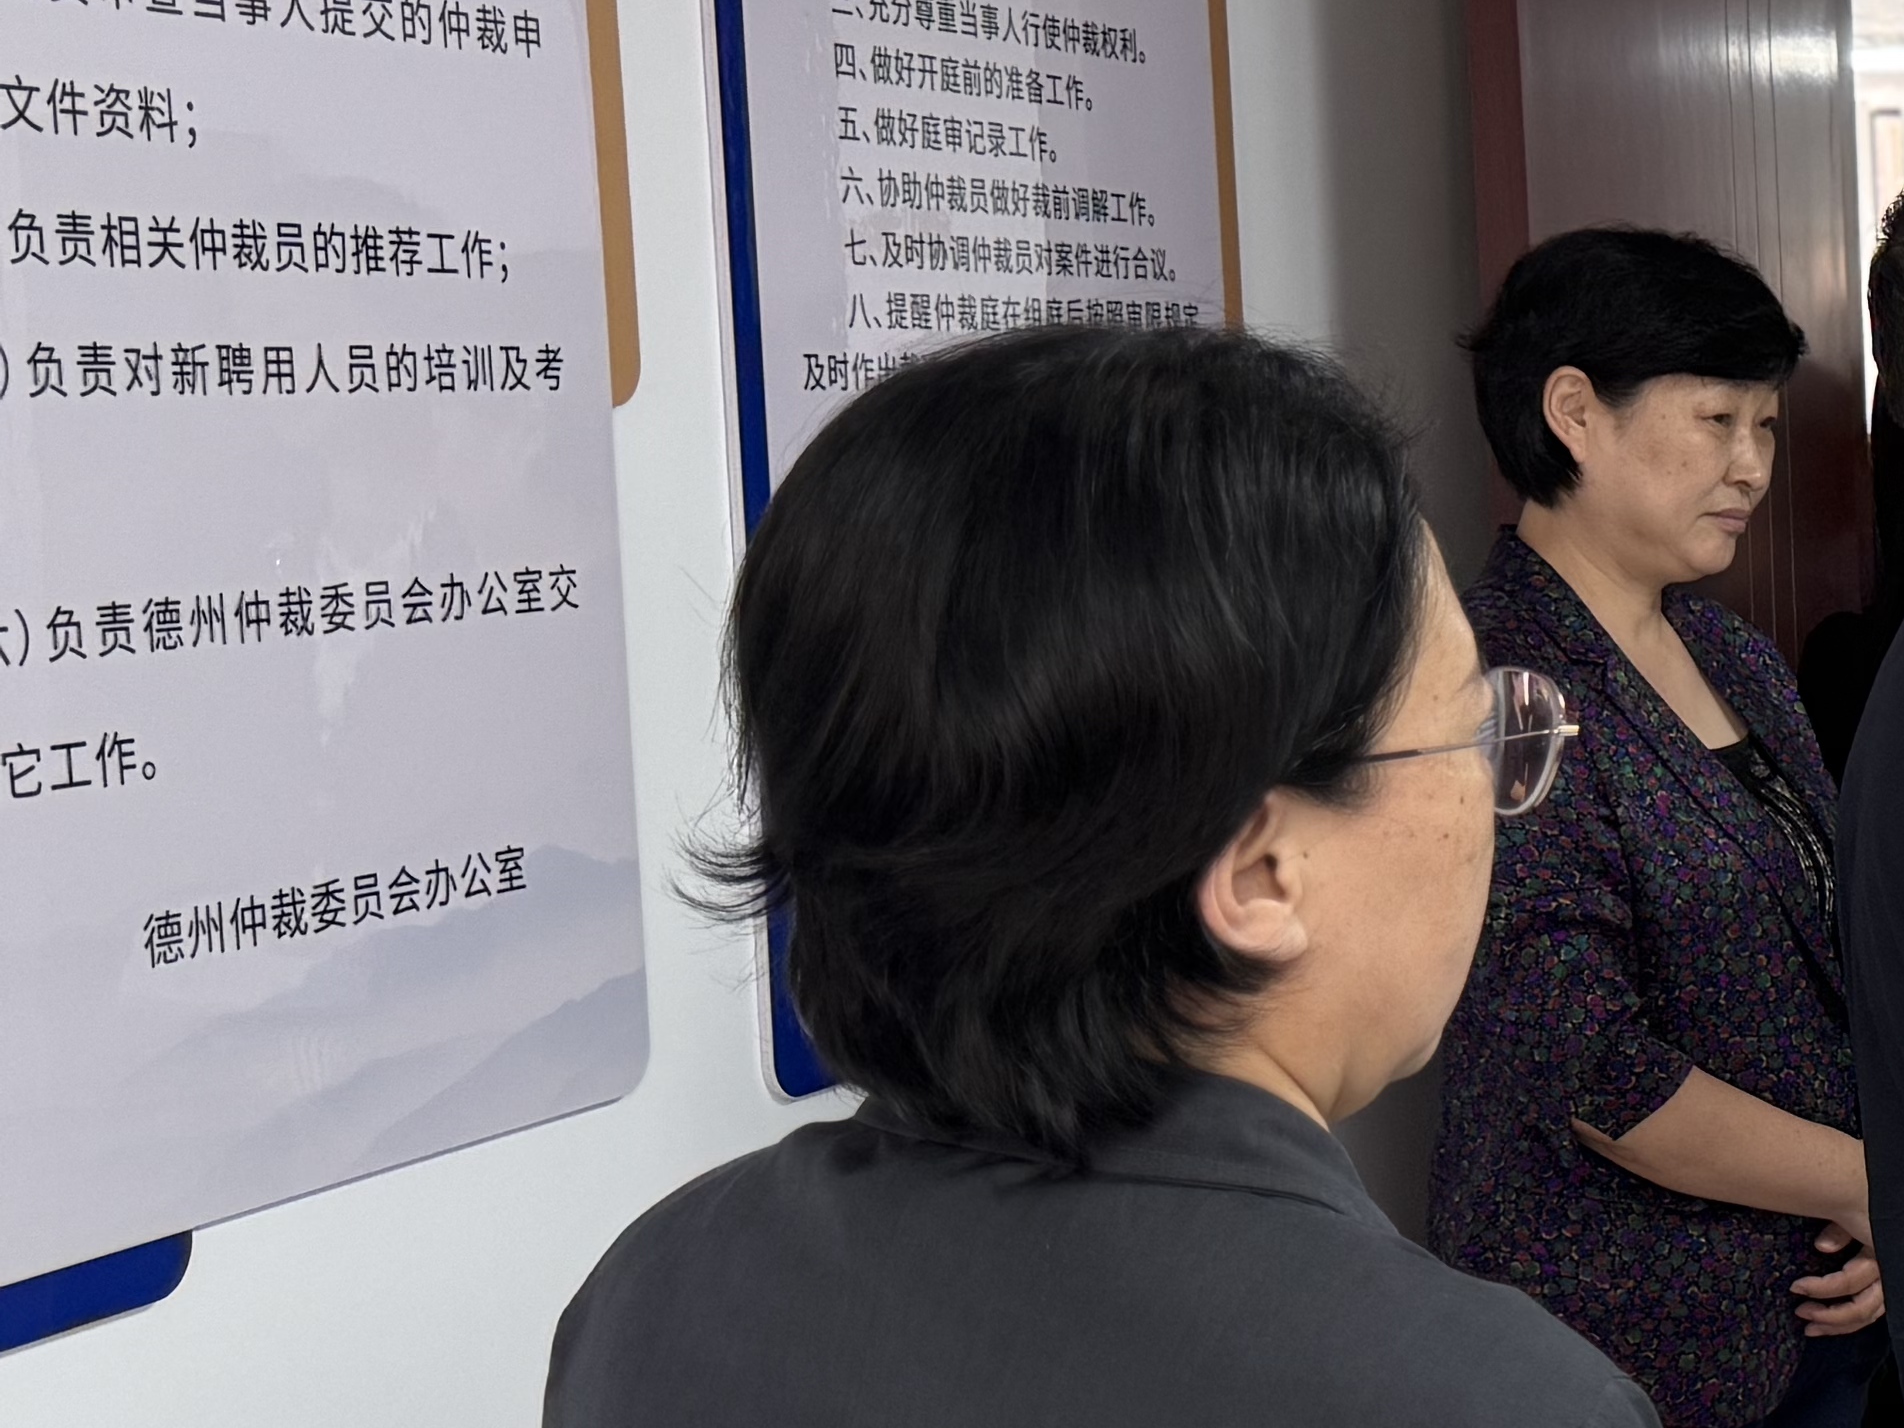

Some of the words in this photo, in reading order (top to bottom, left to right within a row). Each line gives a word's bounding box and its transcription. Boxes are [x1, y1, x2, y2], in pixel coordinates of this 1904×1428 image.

[0, 74, 198, 146] 文件资料；
[833, 42, 1093, 112] 四、做好开庭前的准备工作。
[837, 105, 1057, 164] 五、做好庭审记录工作。
[840, 167, 1156, 227] 六、协助仲裁员做好裁前调解工作。
[844, 230, 1176, 283] 七、及时协调仲裁员对案件进行合议。
[0, 563, 581, 667] ）负责德州仲裁委员会办公室交
[2, 731, 158, 799] 它工作。
[142, 843, 528, 969] 德州仲裁委员会办公室
